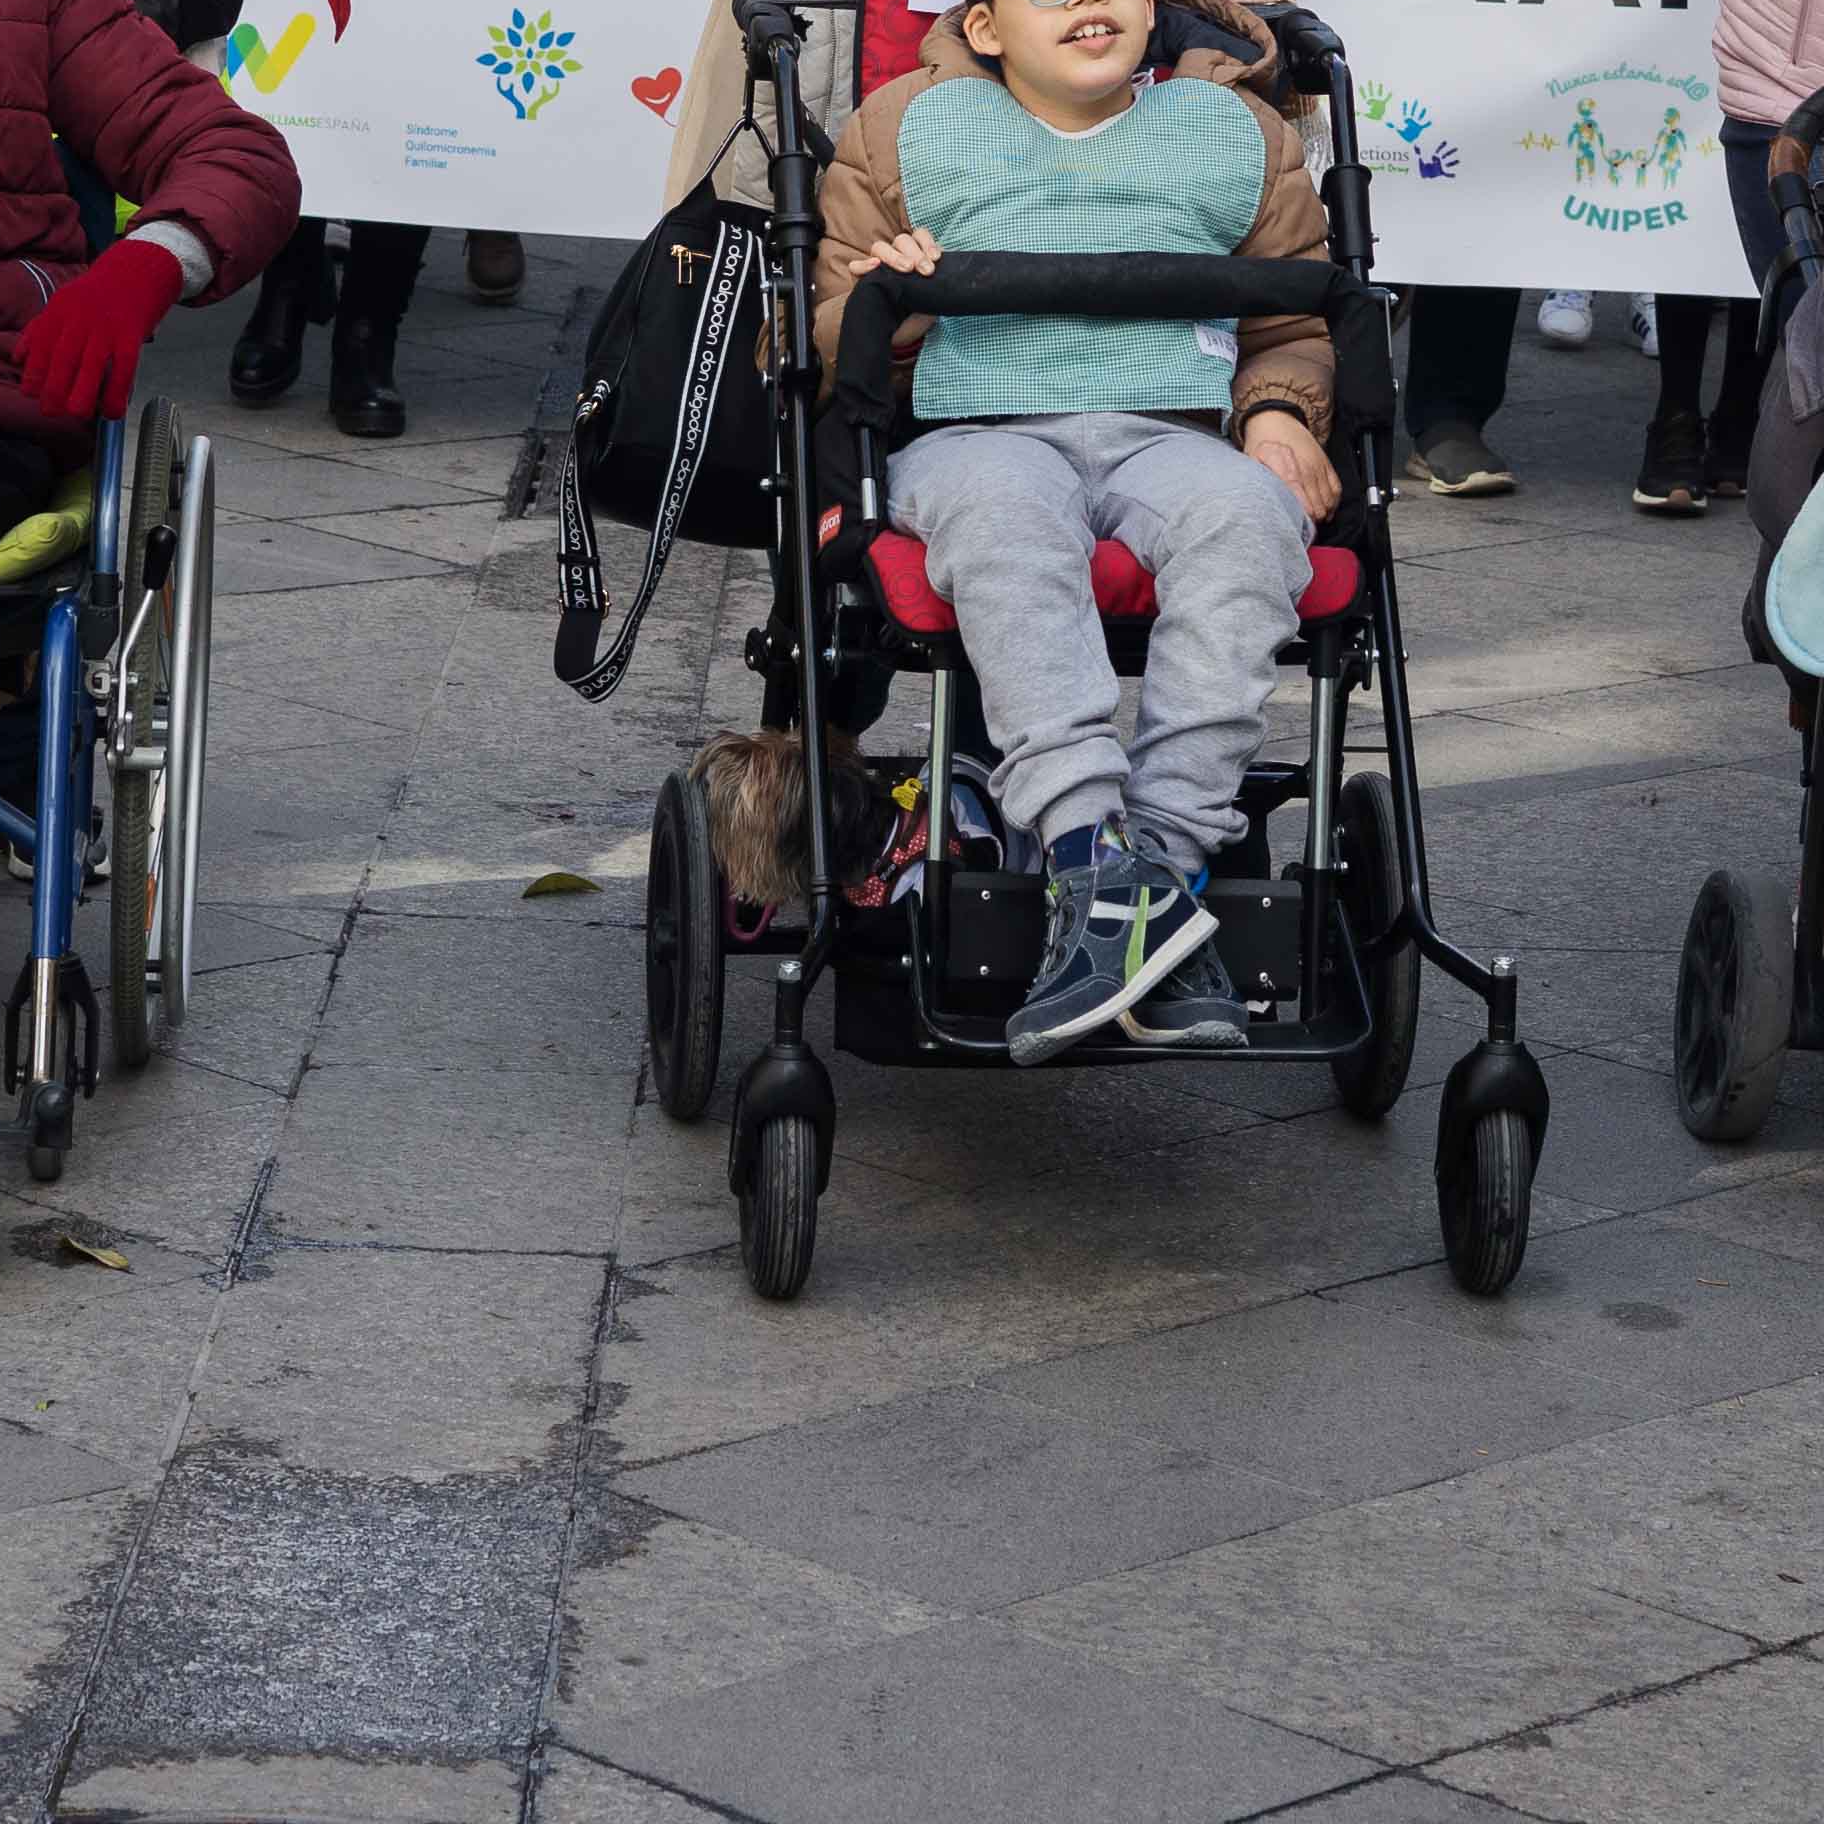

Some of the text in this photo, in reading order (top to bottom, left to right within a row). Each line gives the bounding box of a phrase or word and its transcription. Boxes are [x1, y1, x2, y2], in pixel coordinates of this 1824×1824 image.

[1545, 72, 1600, 99] Nunca
[1667, 74, 1710, 101] sol@
[405, 123, 459, 139] Síndrome
[404, 156, 448, 169] Familiar
[405, 139, 497, 158] Quilomicronemia
[1563, 194, 1689, 232] UNIPER
[723, 245, 743, 276] don
[706, 280, 734, 345] algodon
[698, 351, 716, 382] don
[686, 385, 708, 451] algodon
[674, 458, 690, 489] don
[564, 487, 582, 551] algodon
[658, 492, 680, 559] algodon
[592, 665, 619, 690] don
